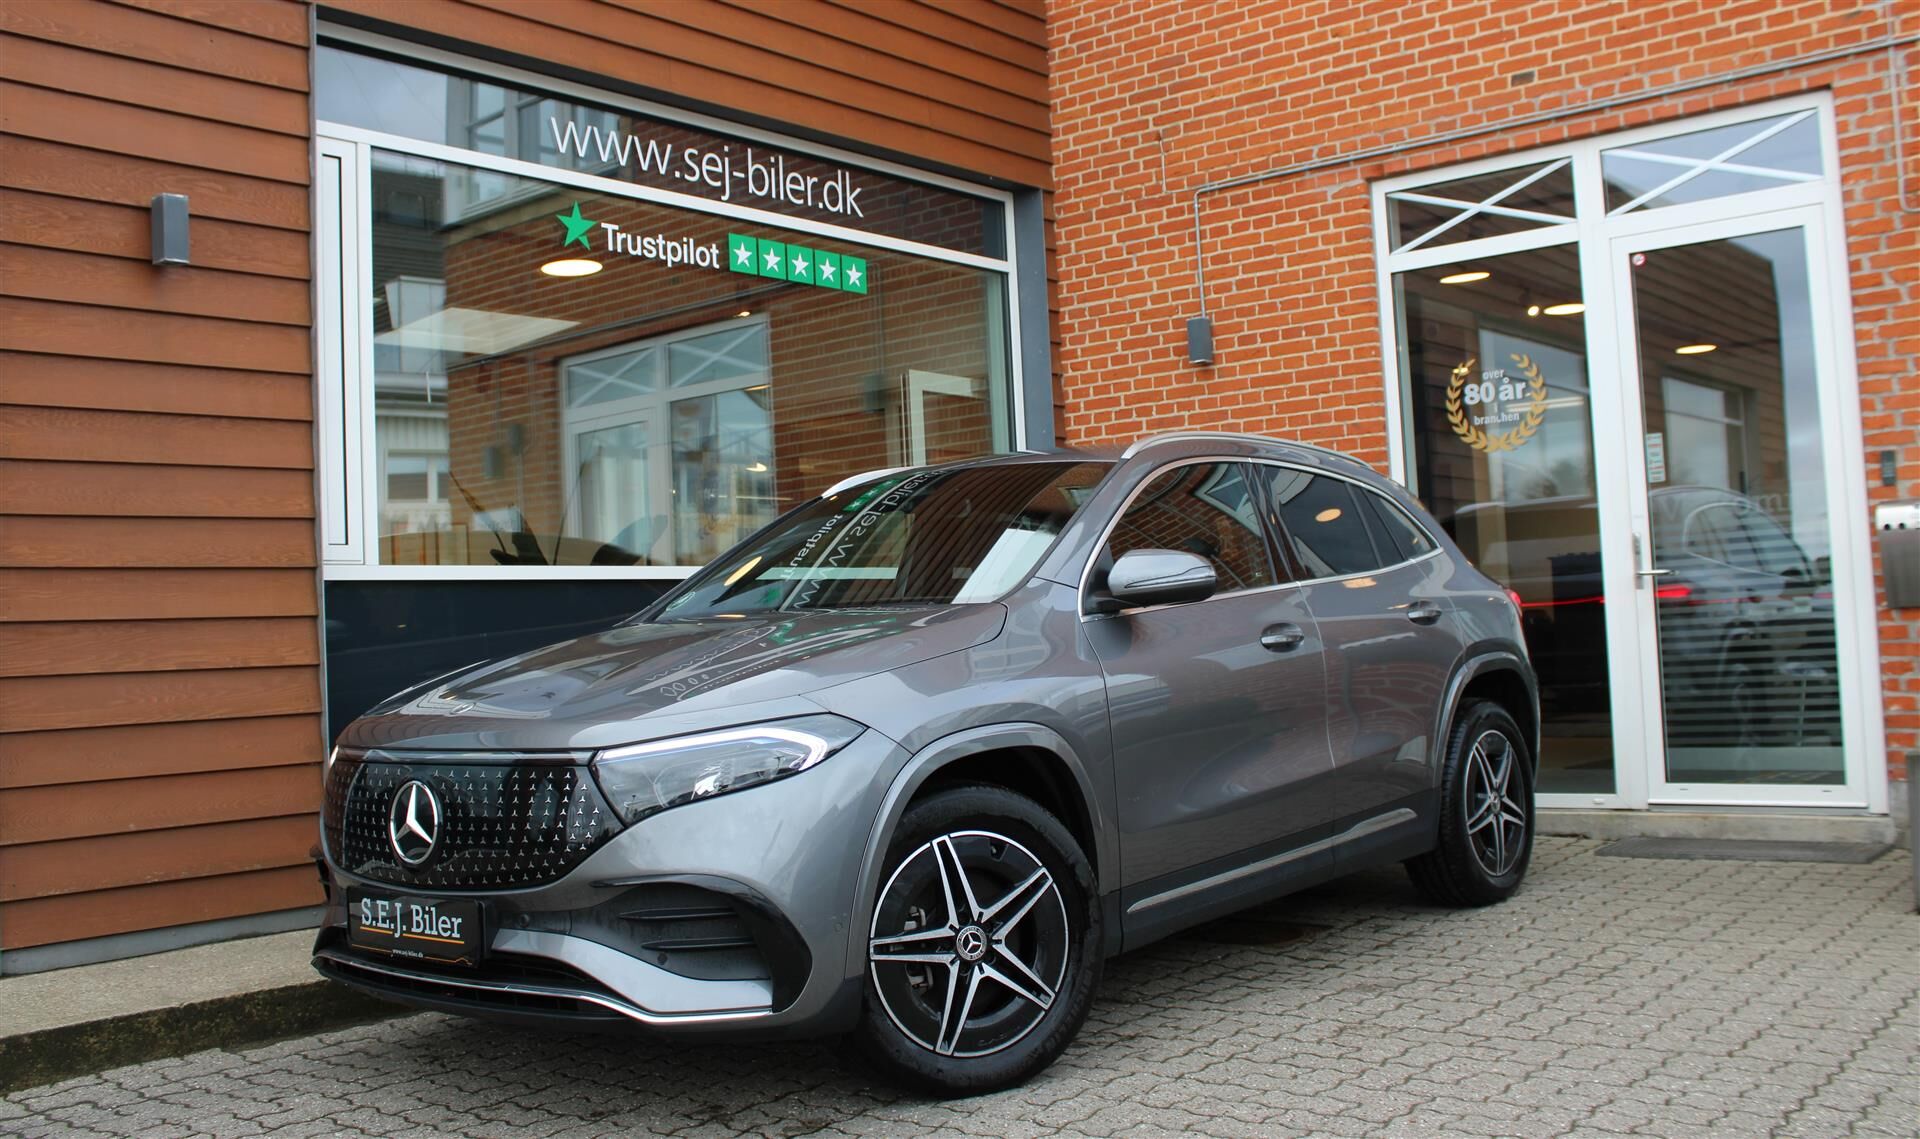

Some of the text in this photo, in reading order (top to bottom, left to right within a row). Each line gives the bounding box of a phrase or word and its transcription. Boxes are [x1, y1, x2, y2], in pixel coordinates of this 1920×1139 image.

[550, 116, 865, 219] www.sej-biler.dk
[601, 222, 720, 270] Trustpilot
[1464, 377, 1526, 405] 80 år
[1482, 369, 1504, 380] over
[360, 897, 463, 939] S.E.J. Biler
